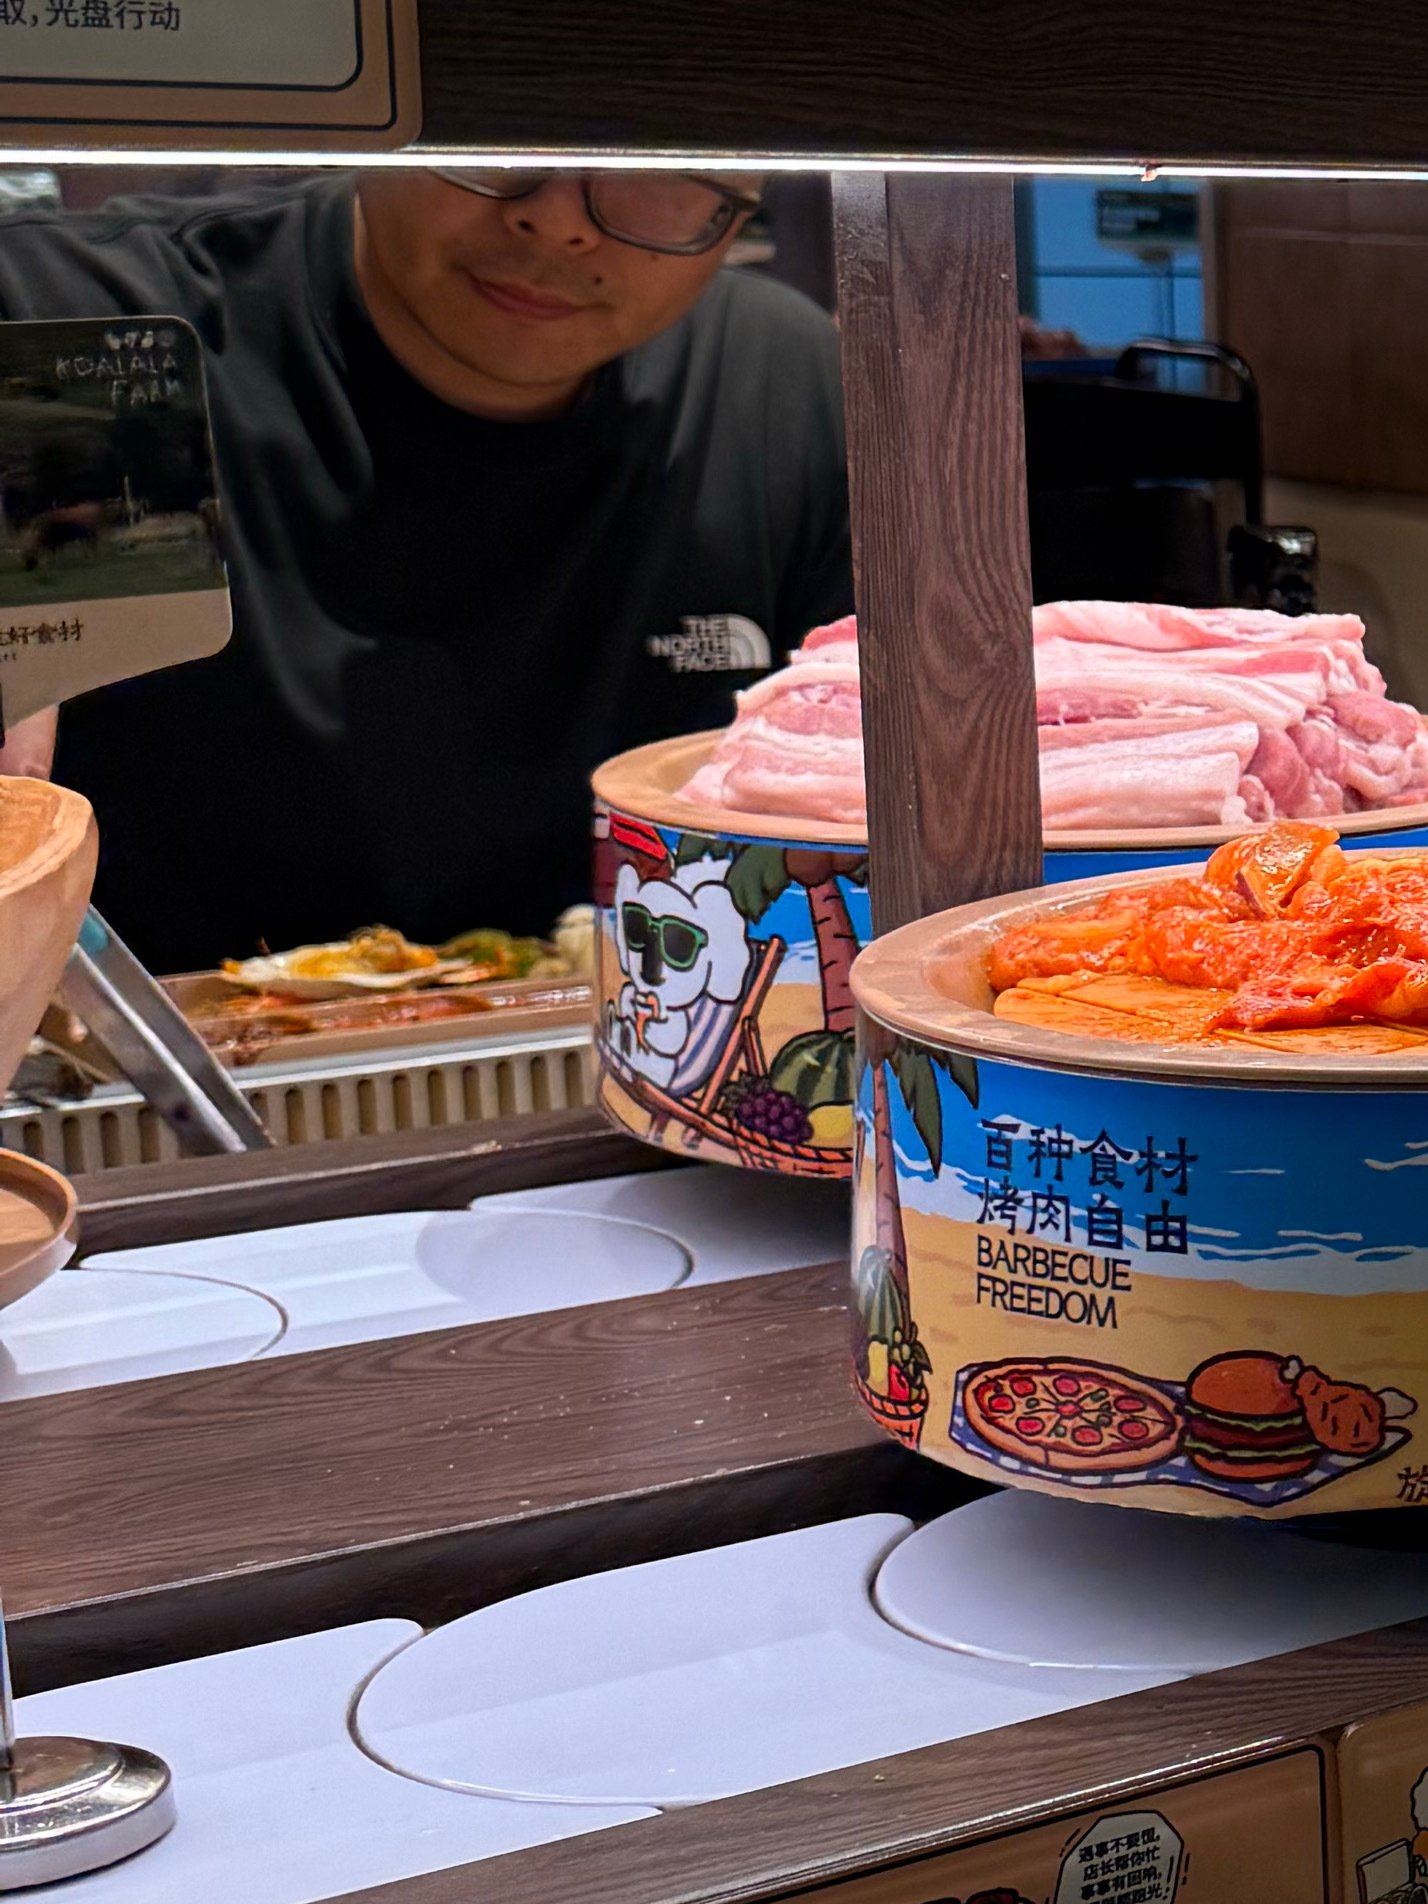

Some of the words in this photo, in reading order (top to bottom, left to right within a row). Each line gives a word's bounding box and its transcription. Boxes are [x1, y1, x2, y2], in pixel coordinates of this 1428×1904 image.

[0, 618, 84, 647] 好食材
[980, 1118, 1200, 1199] 百种食材
[976, 1174, 1190, 1256] 烤肉自由
[975, 1233, 1133, 1294] BARBECUE
[975, 1278, 1121, 1332] FREEDOM
